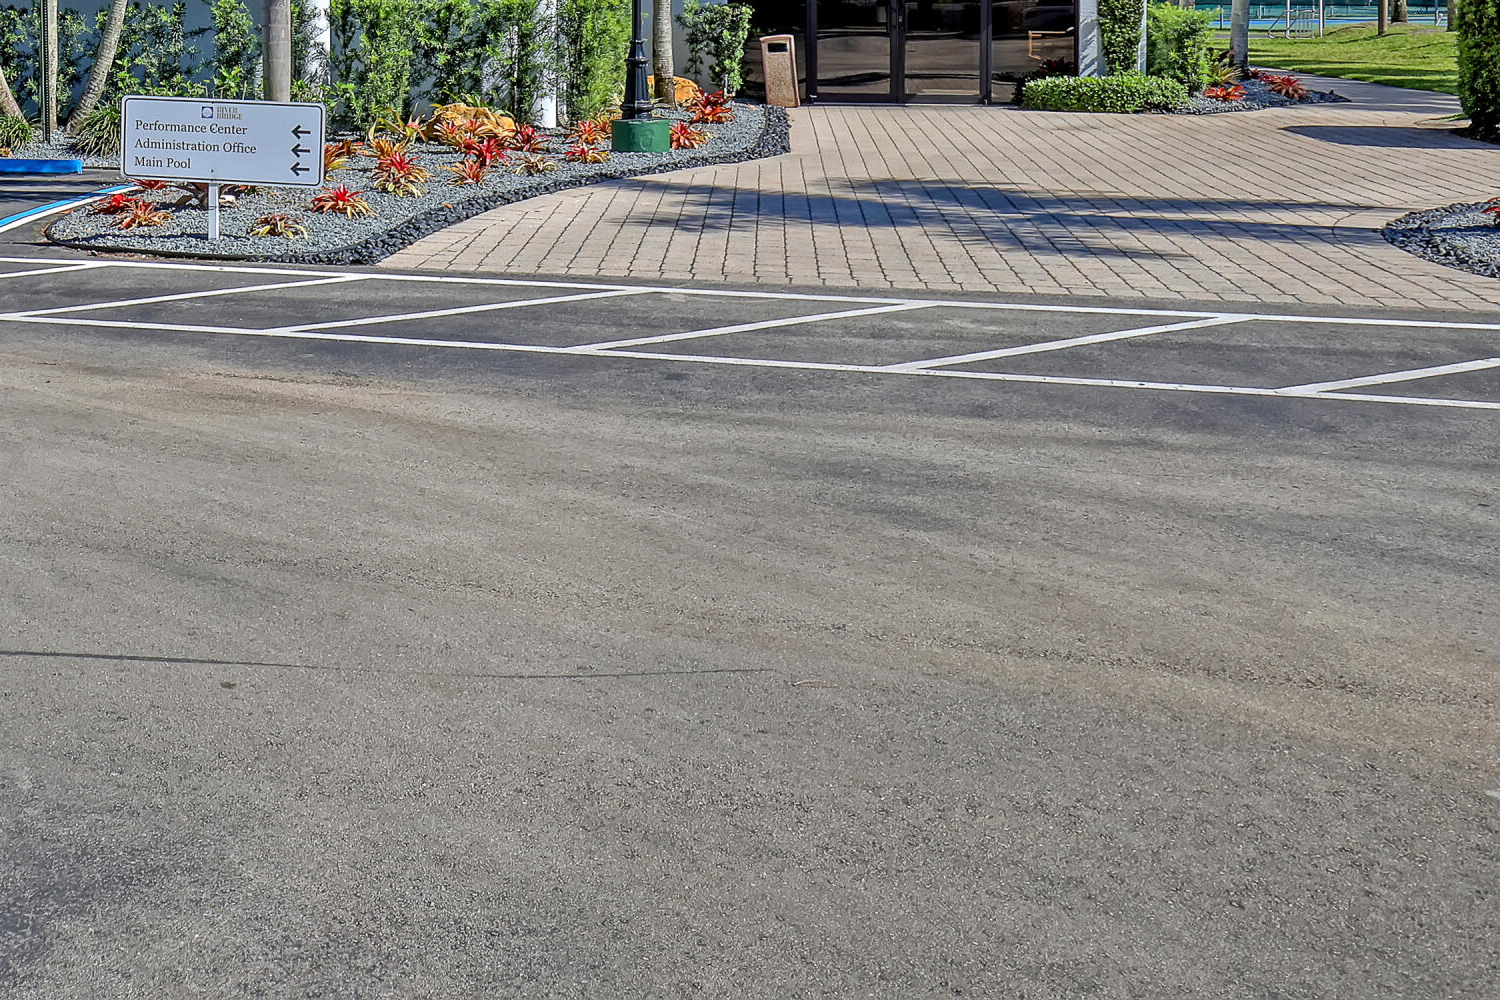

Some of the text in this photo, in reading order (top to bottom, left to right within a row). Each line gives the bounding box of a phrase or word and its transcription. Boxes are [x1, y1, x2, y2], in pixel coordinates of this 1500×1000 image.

[216, 112, 243, 120] BRIDGE
[135, 120, 248, 135] Performance Center
[134, 138, 257, 154] Administration Office
[134, 156, 191, 169] Main Pool
